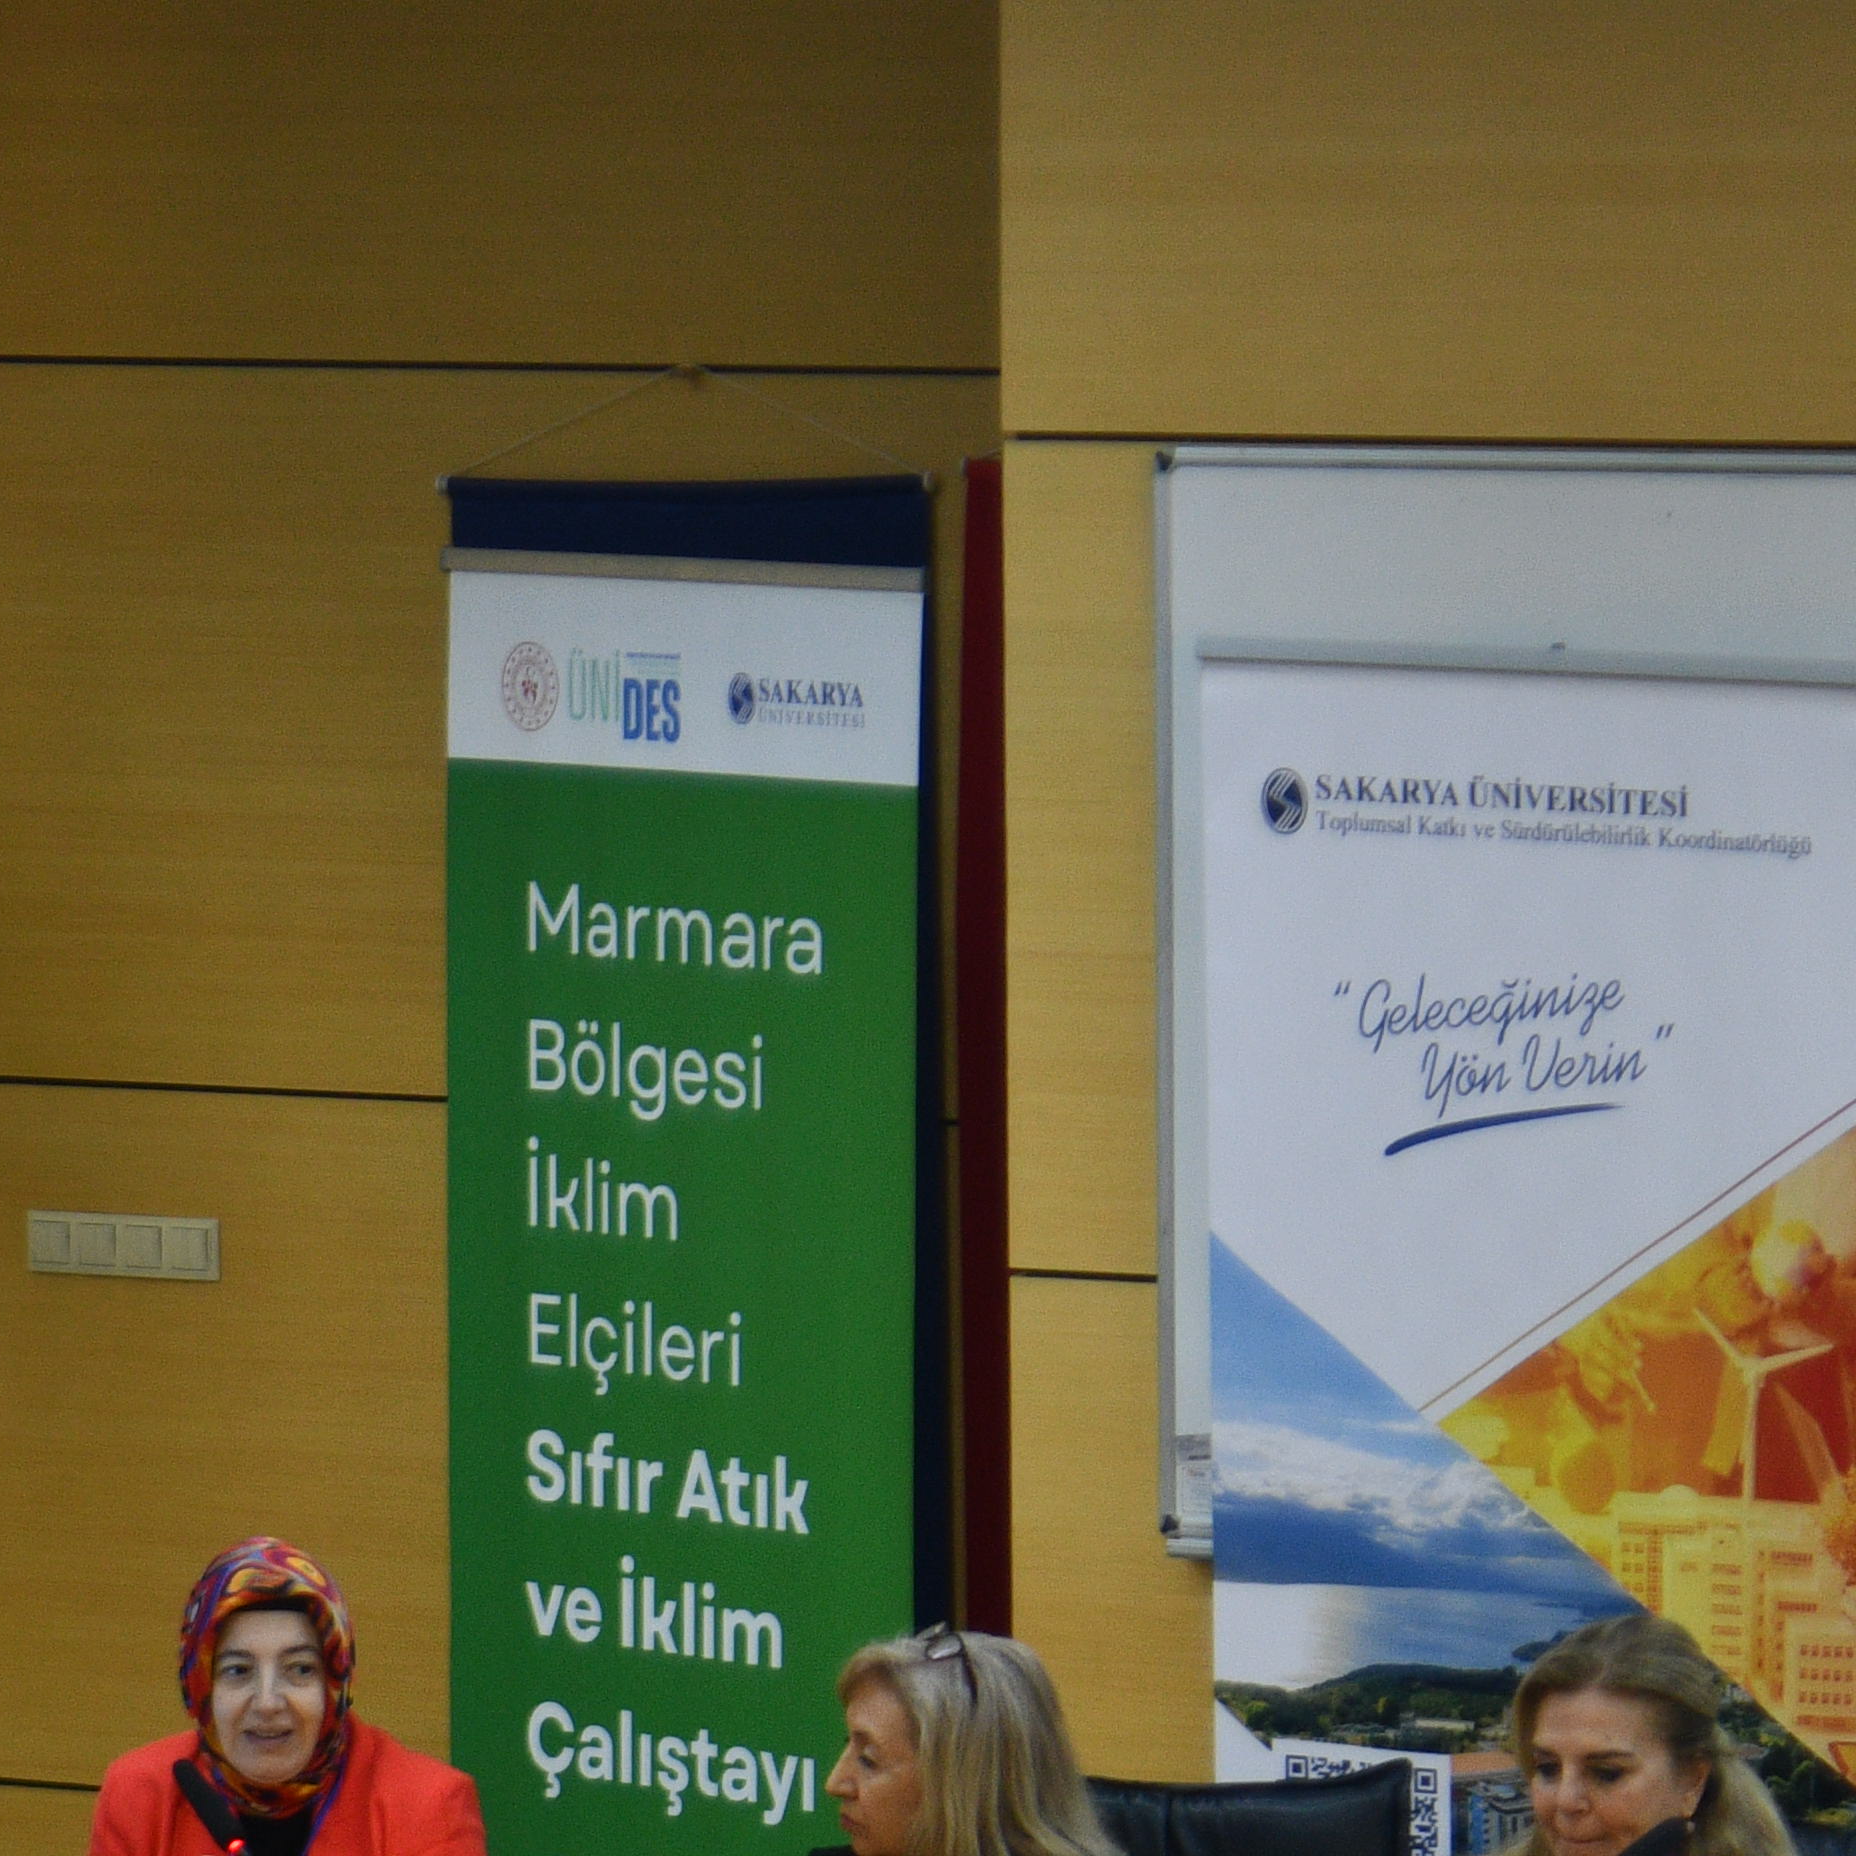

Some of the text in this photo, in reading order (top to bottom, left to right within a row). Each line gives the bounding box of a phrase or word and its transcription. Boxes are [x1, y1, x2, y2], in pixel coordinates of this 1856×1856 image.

[757, 678, 863, 707] SAKARYA
[1315, 774, 1689, 817] SAKARYA ÜNİVERSİTESİ
[1316, 810, 1411, 836] Toplumsal
[1418, 815, 1465, 837] Katkı
[1473, 823, 1494, 838] ve
[528, 881, 824, 975] Marmara
[529, 1019, 763, 1121] Bölgesi
[1420, 1041, 1512, 1118] Yön
[529, 1136, 678, 1241] İklim
[529, 1293, 741, 1396] Elçileri
[525, 1429, 810, 1535] Sıfır Atık
[525, 1555, 783, 1671] ve İklim
[527, 1701, 815, 1828] Çalıştayı
